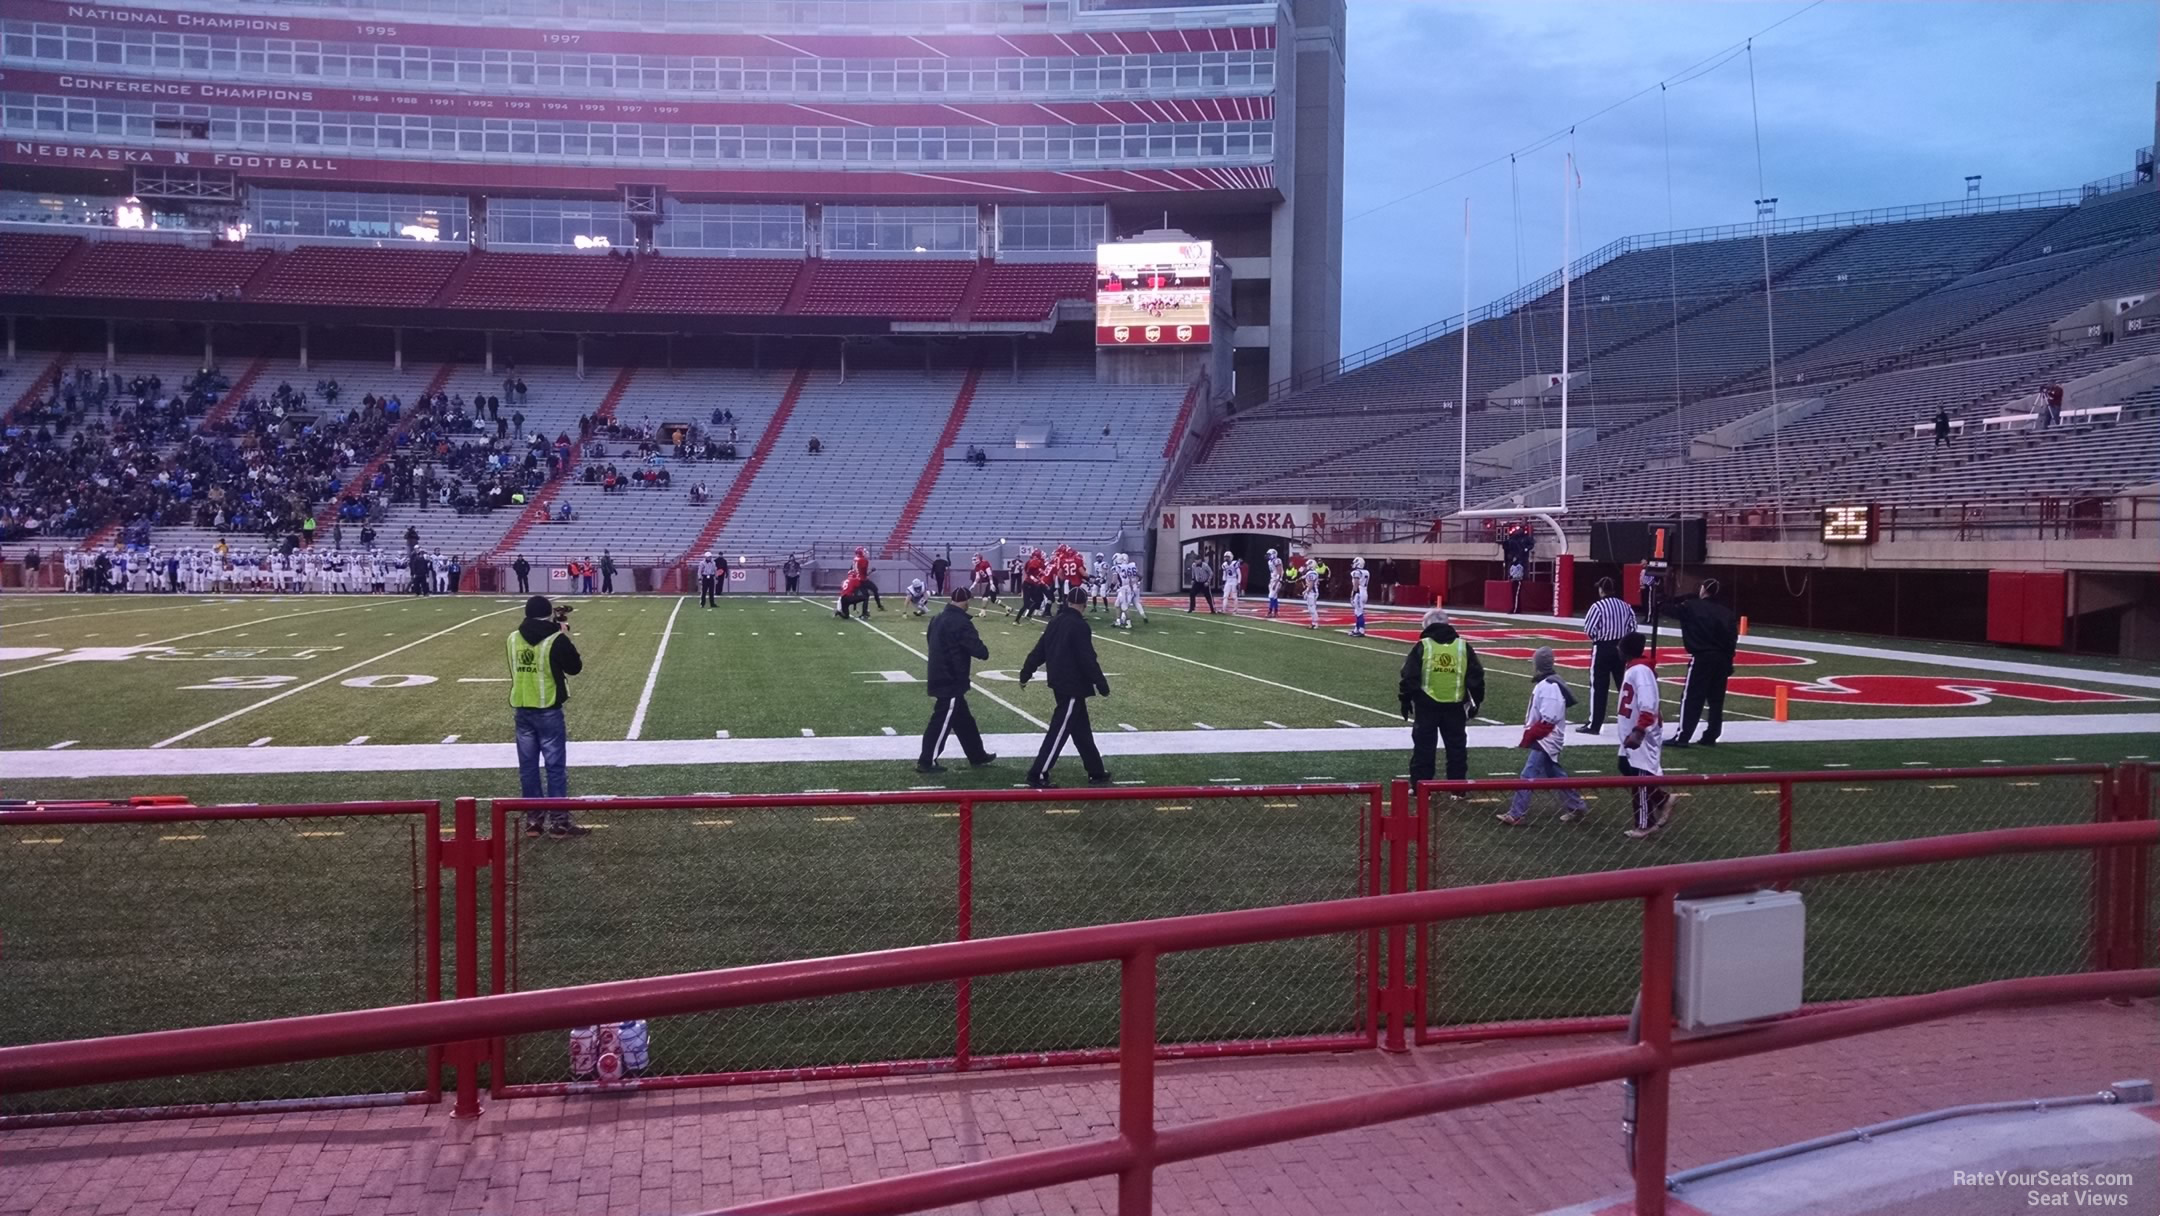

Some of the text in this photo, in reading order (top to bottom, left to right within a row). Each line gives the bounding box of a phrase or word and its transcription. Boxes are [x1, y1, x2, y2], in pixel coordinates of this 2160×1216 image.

[68, 6, 581, 44] NATIONAL CHAMPIONS 1995 1997
[59, 76, 192, 95] CONFERENCE
[201, 85, 313, 103] CHAMPIONS
[504, 101, 531, 109] 1993
[653, 106, 679, 114] 1999
[16, 143, 338, 171] NEBRASKA N FOOTBALL
[1162, 513, 1176, 529] N
[1191, 513, 1297, 529] NEBRASKA
[1312, 512, 1326, 529] N
[1825, 507, 1868, 539] 25
[1654, 528, 1665, 559] 1
[553, 570, 567, 579] 29
[731, 571, 745, 580] 30
[1062, 562, 1077, 576] 32
